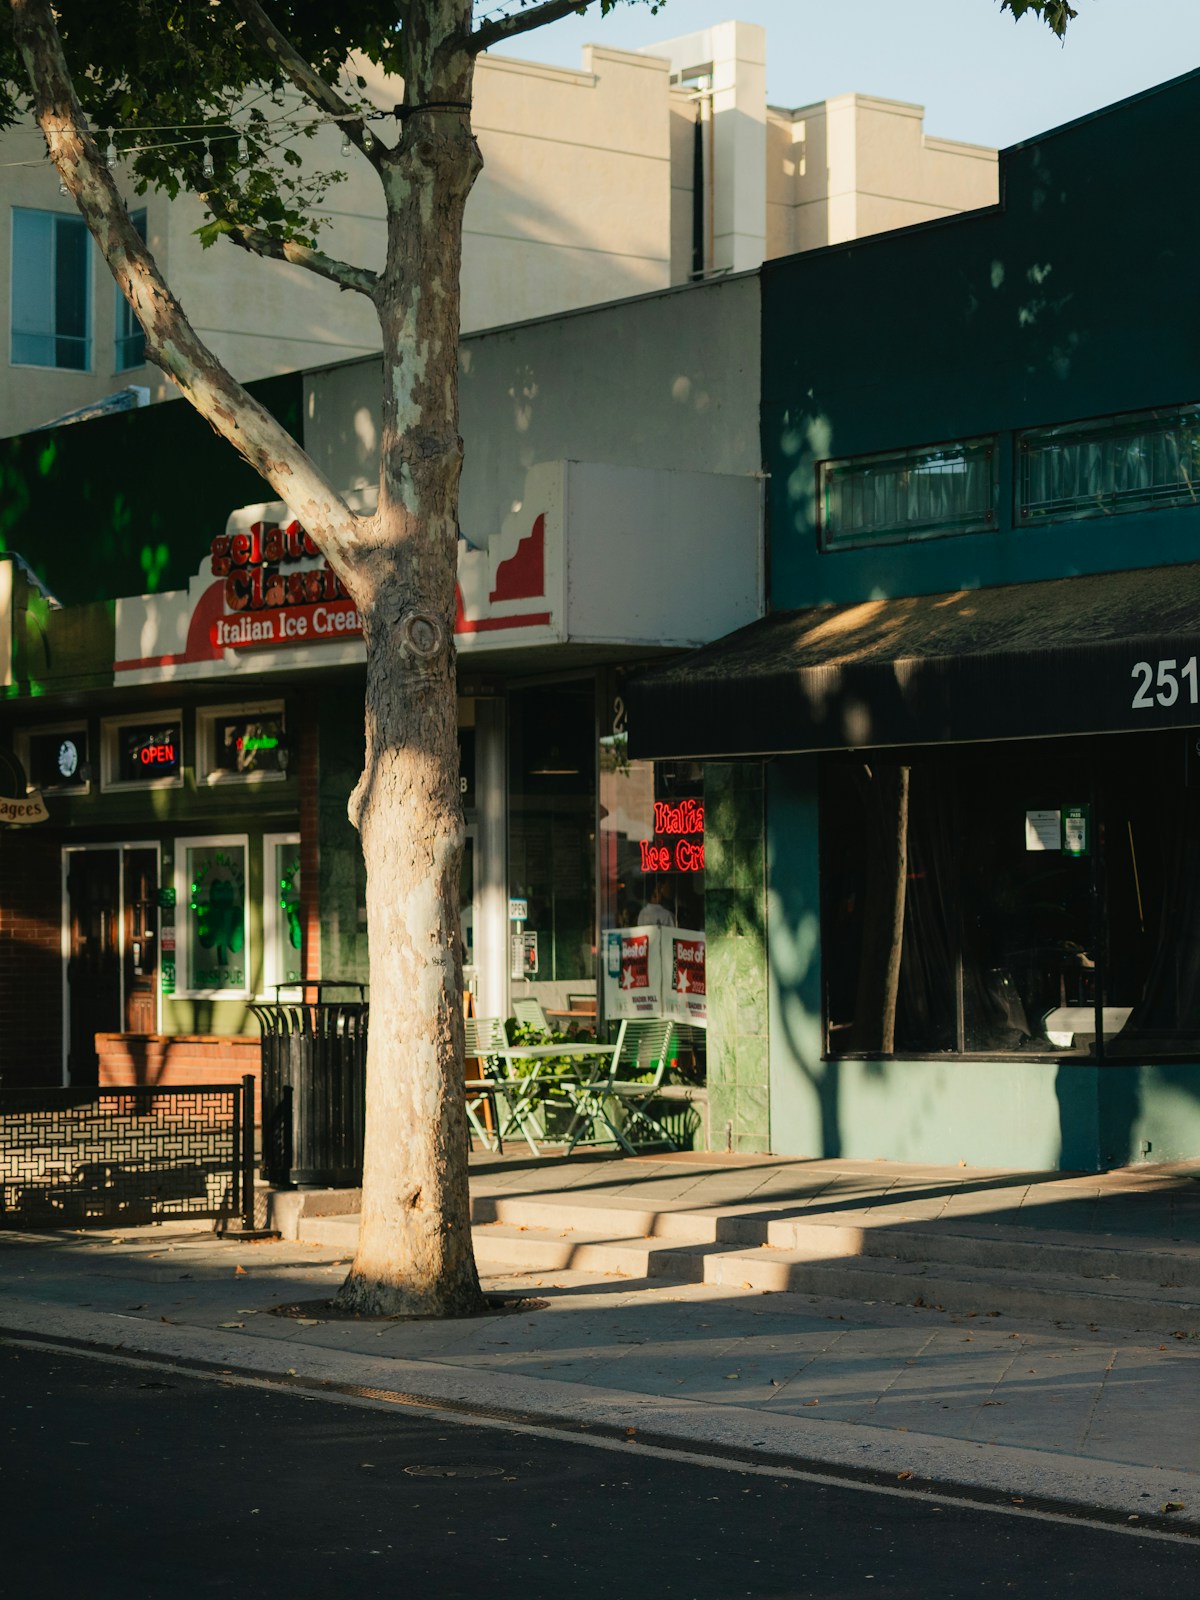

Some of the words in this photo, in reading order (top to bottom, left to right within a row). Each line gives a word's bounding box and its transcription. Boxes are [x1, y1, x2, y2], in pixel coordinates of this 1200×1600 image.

[216, 617, 274, 645] Italian
[278, 612, 307, 638] Ice
[1131, 656, 1199, 709] 251
[140, 744, 175, 764] OPEN
[0, 803, 42, 820] agees
[653, 799, 704, 834] Italia
[639, 839, 671, 871] Ice
[622, 942, 638, 958] Best
[638, 939, 648, 956] of
[677, 943, 694, 962] Best
[694, 944, 705, 963] of
[691, 981, 705, 993] 2022
